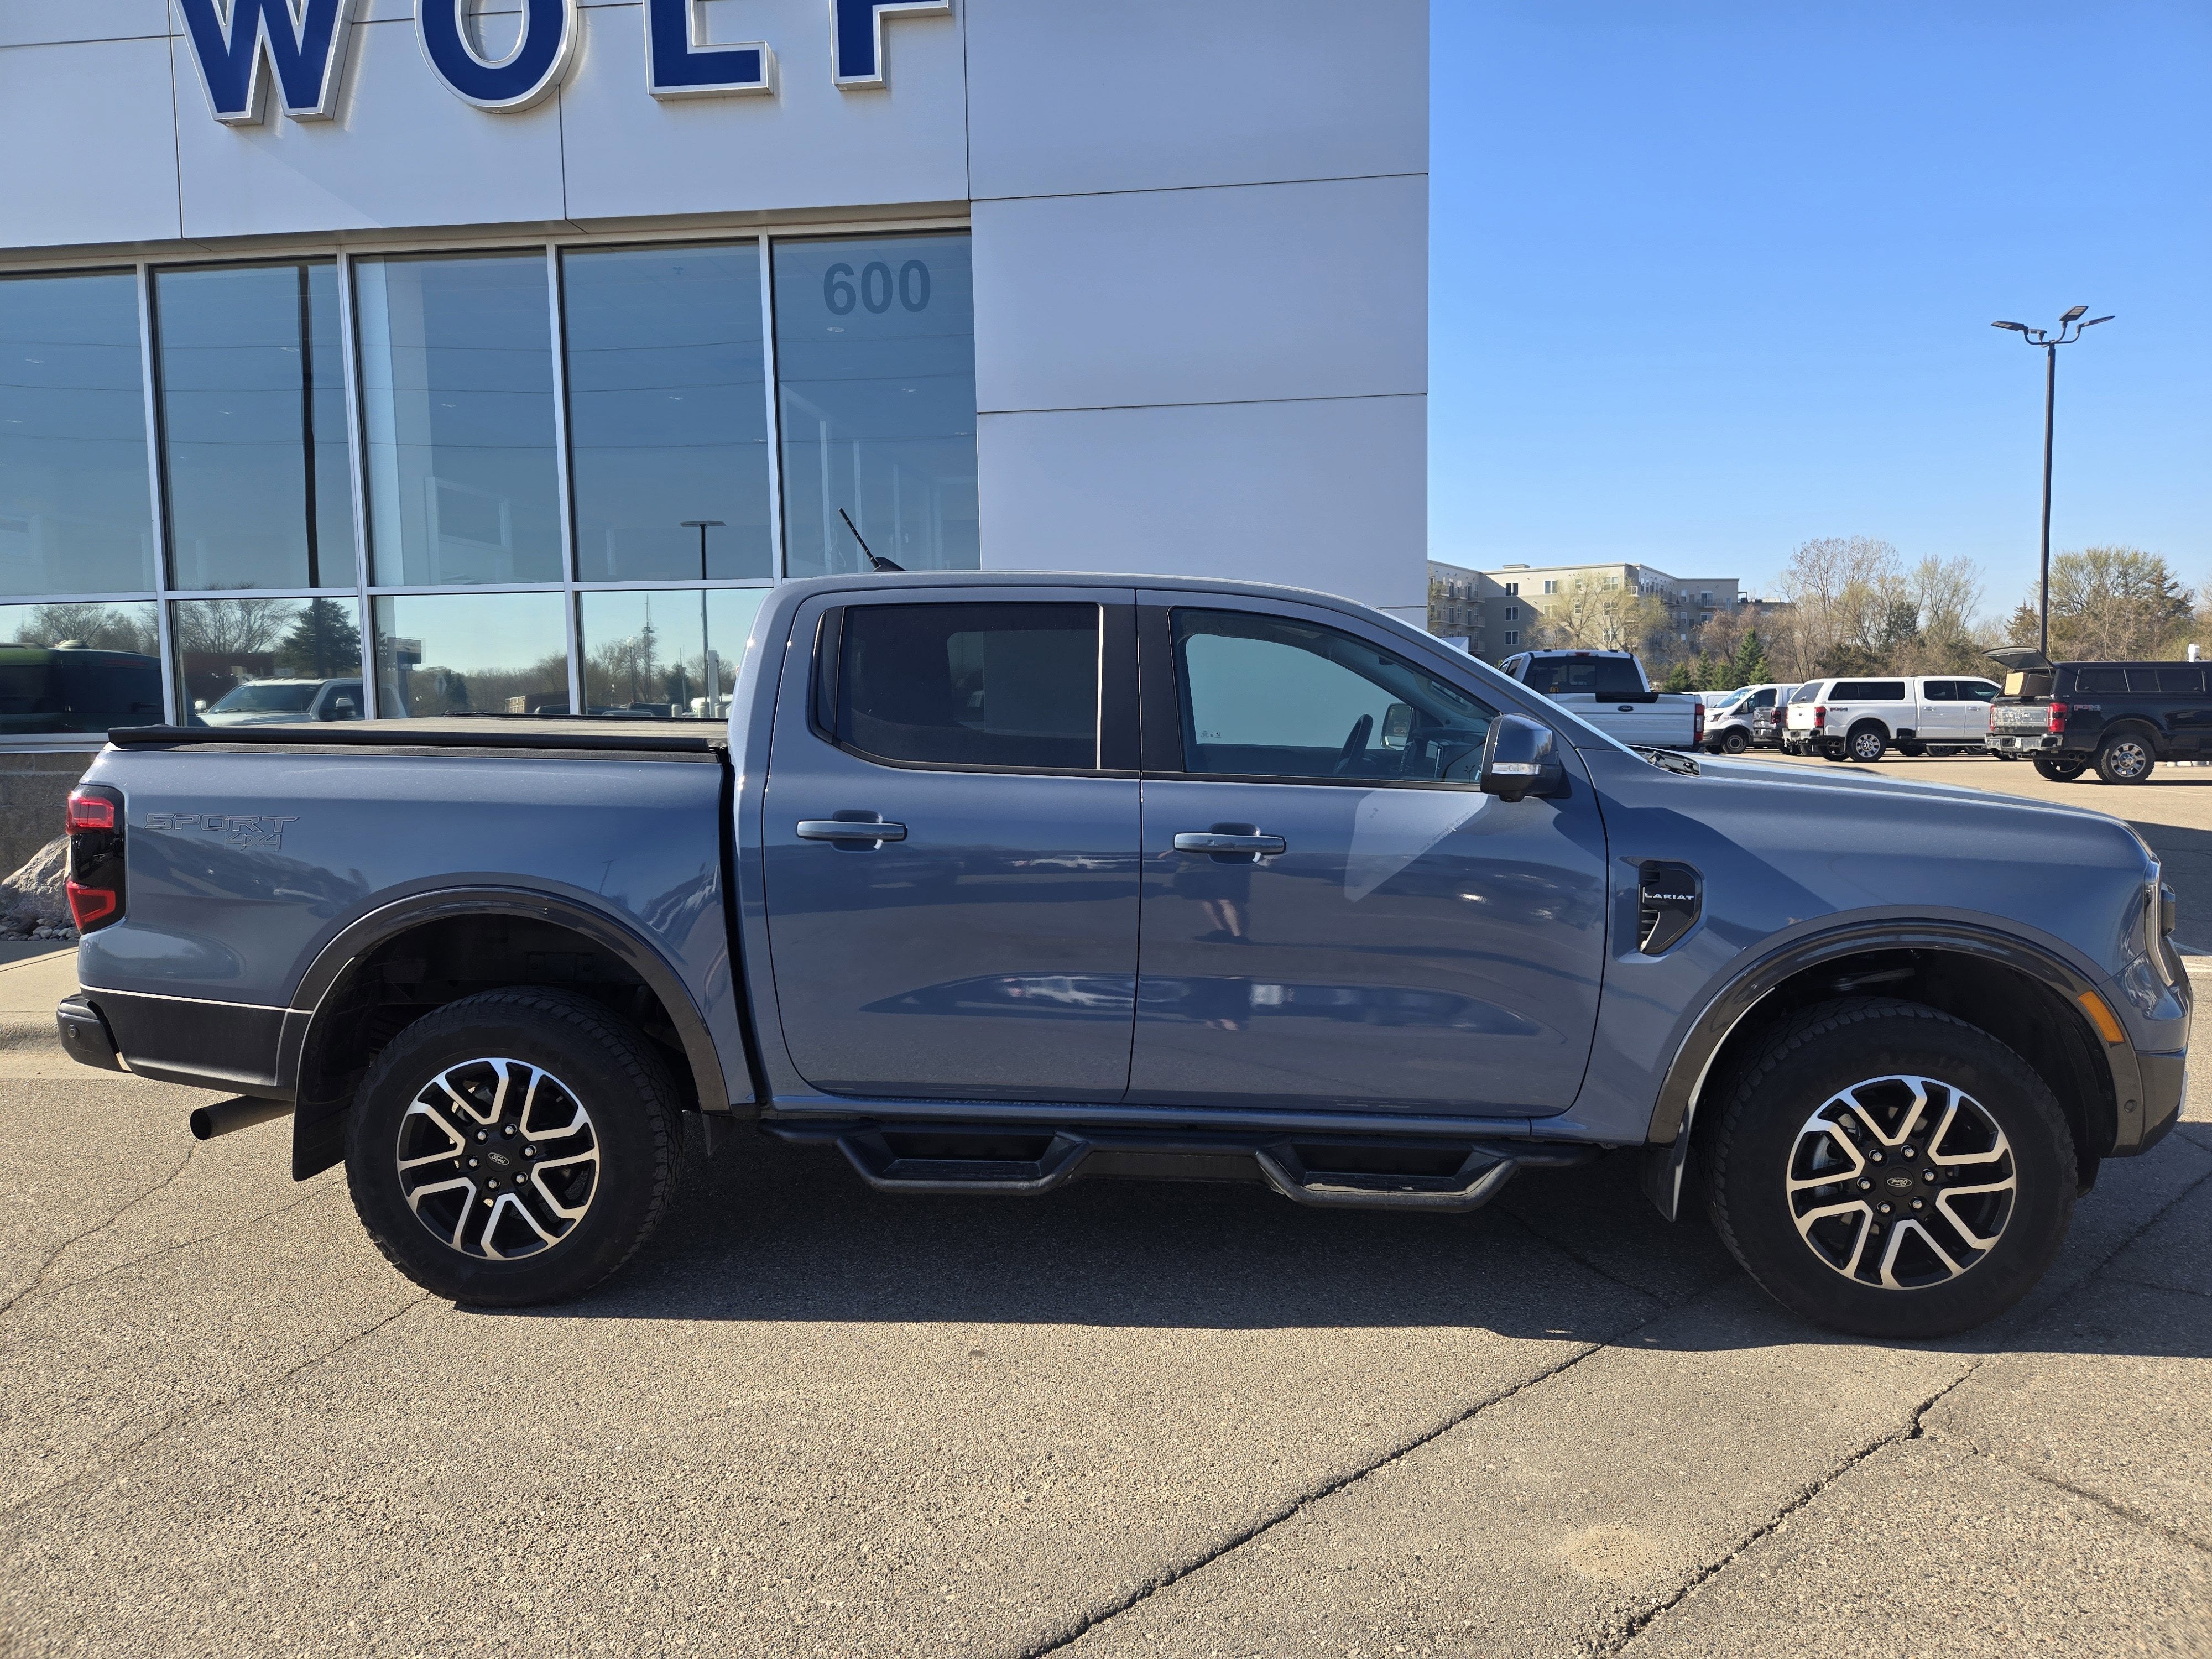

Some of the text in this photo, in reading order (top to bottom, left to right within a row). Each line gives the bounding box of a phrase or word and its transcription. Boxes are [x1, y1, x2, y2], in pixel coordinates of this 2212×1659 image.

[823, 259, 931, 315] 600
[144, 813, 300, 833] SPORT
[1645, 892, 1694, 900] LARIAT
[491, 1153, 506, 1164] Ford
